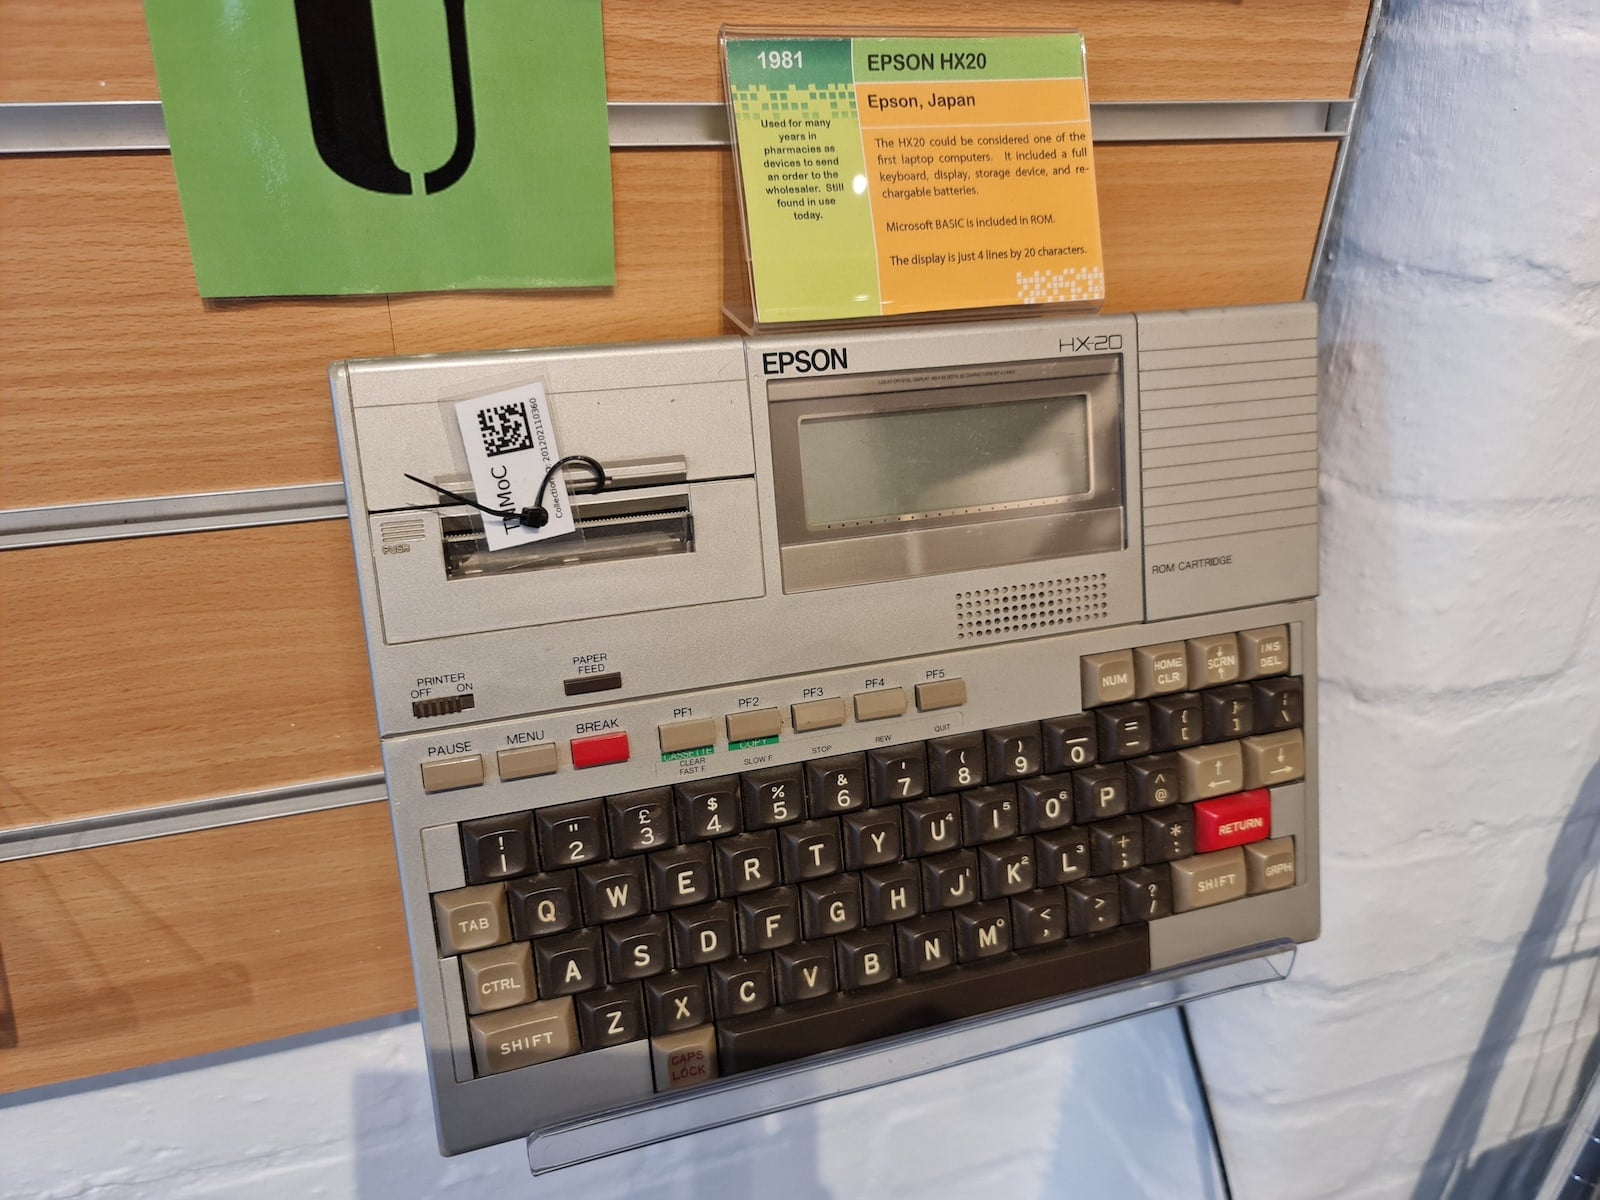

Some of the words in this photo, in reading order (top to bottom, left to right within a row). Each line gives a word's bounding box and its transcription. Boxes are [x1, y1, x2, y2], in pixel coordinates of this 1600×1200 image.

[758, 51, 802, 69] 1981
[867, 54, 934, 72] EPSON
[940, 52, 986, 71] HX20
[868, 94, 923, 111] Epson,
[928, 93, 976, 111] Japan
[761, 119, 786, 128] Used
[789, 119, 801, 127] for
[805, 119, 831, 129] many
[779, 133, 805, 142] years
[808, 131, 816, 140] in
[876, 138, 894, 148] The
[899, 137, 925, 147] HX20
[929, 136, 956, 147] could
[960, 135, 974, 146] be
[977, 134, 1029, 145] considered
[1033, 135, 1051, 144] one
[1056, 132, 1065, 142] of
[1070, 132, 1086, 142] the
[764, 146, 821, 156] pharmacies
[878, 154, 897, 165] first
[901, 153, 934, 166] laptop
[938, 153, 993, 165] computers.
[1005, 151, 1012, 161] It
[1015, 149, 1056, 160] included
[1072, 147, 1088, 158] full
[763, 159, 801, 168] devices
[816, 157, 839, 166] send
[782, 172, 808, 180] order
[811, 171, 821, 180] to
[823, 171, 838, 179] the
[880, 170, 929, 182] keyboard,
[934, 169, 971, 181] display,
[975, 168, 1010, 180] storage
[1015, 166, 1049, 178] device,
[1052, 165, 1071, 175] and
[1075, 166, 1089, 174] re-
[766, 185, 821, 194] wholesaler.
[826, 183, 844, 192] Still
[882, 186, 931, 200] chargable
[933, 185, 979, 197] batteries.
[777, 198, 804, 208] found
[807, 198, 816, 206] in
[794, 211, 823, 221] today.
[886, 216, 933, 232] Microsoft
[935, 217, 965, 230] BASIC
[966, 217, 974, 228] is
[976, 215, 1017, 227] included
[1019, 214, 1028, 225] in
[1031, 214, 1056, 224] ROM.
[890, 255, 909, 266] The
[911, 253, 946, 266] display
[948, 252, 956, 263] is
[958, 251, 976, 263] just
[977, 251, 984, 260] 4
[986, 249, 1008, 260] lines
[1010, 249, 1022, 261] by
[1024, 248, 1036, 258] 20
[1037, 246, 1088, 257] characters.
[762, 347, 848, 375] EPSON
[1059, 334, 1123, 353] HX-20
[529, 397, 550, 462] 201202110360
[383, 544, 410, 555] PUSH
[1152, 563, 1174, 575] ROM
[1178, 555, 1232, 571] CARTRIDGE
[1261, 642, 1280, 653] INS
[573, 653, 607, 665] PAPER
[1154, 657, 1183, 671] HOME
[1208, 655, 1235, 669] SCRN
[1261, 657, 1282, 667] DEL
[578, 664, 605, 674] FEED
[926, 669, 945, 679] PF5
[417, 672, 466, 687] PRINTER
[865, 678, 885, 689] PF4
[1102, 673, 1127, 687] NUM
[1158, 672, 1180, 685] CLR
[411, 688, 432, 699] OFF
[457, 682, 473, 693] ON
[803, 687, 824, 699] PF3
[738, 697, 759, 708] PF2
[673, 707, 693, 719] PF1
[576, 718, 619, 734] BREAK
[934, 722, 951, 733] QUIT
[506, 730, 545, 745] MENU
[875, 734, 891, 744] REW
[428, 740, 473, 757] PAUSE
[811, 744, 832, 754] STOP
[679, 756, 706, 767] CLEAR
[744, 755, 765, 765] SLOW
[767, 754, 773, 763] F
[1014, 756, 1028, 773] 9
[679, 766, 699, 776] FAST
[700, 766, 706, 774] F
[958, 766, 971, 784] 8
[837, 774, 848, 786] &
[898, 777, 912, 796] 7
[771, 785, 785, 799] %
[837, 790, 850, 806] 6
[1100, 786, 1114, 808] P
[707, 797, 718, 811] $
[773, 802, 787, 819] 5
[638, 809, 651, 824] £
[706, 814, 721, 832] 4
[1218, 818, 1263, 836] RETURN
[640, 827, 654, 845] 3
[871, 832, 886, 852] Y
[569, 841, 585, 860] 2
[809, 844, 824, 866] T
[743, 857, 761, 881] R
[1265, 862, 1292, 878] GRPH
[678, 870, 696, 894] E
[1198, 873, 1236, 892] SHIFT
[606, 884, 629, 908] W
[891, 887, 905, 910] H
[538, 900, 556, 922] Q
[829, 902, 845, 922] G
[458, 917, 489, 934] TAB
[766, 914, 781, 937] F
[700, 930, 717, 952] D
[924, 938, 941, 960] N
[634, 945, 651, 967] S
[864, 953, 880, 975] B
[565, 959, 582, 983] A
[803, 966, 818, 988] V
[482, 976, 521, 995] CTRL
[739, 981, 756, 1002] C
[674, 996, 690, 1020] X
[606, 1011, 624, 1035] Z
[500, 1032, 553, 1056] SHIFT
[671, 1050, 704, 1065] CAPS
[672, 1064, 705, 1081] LOCK
